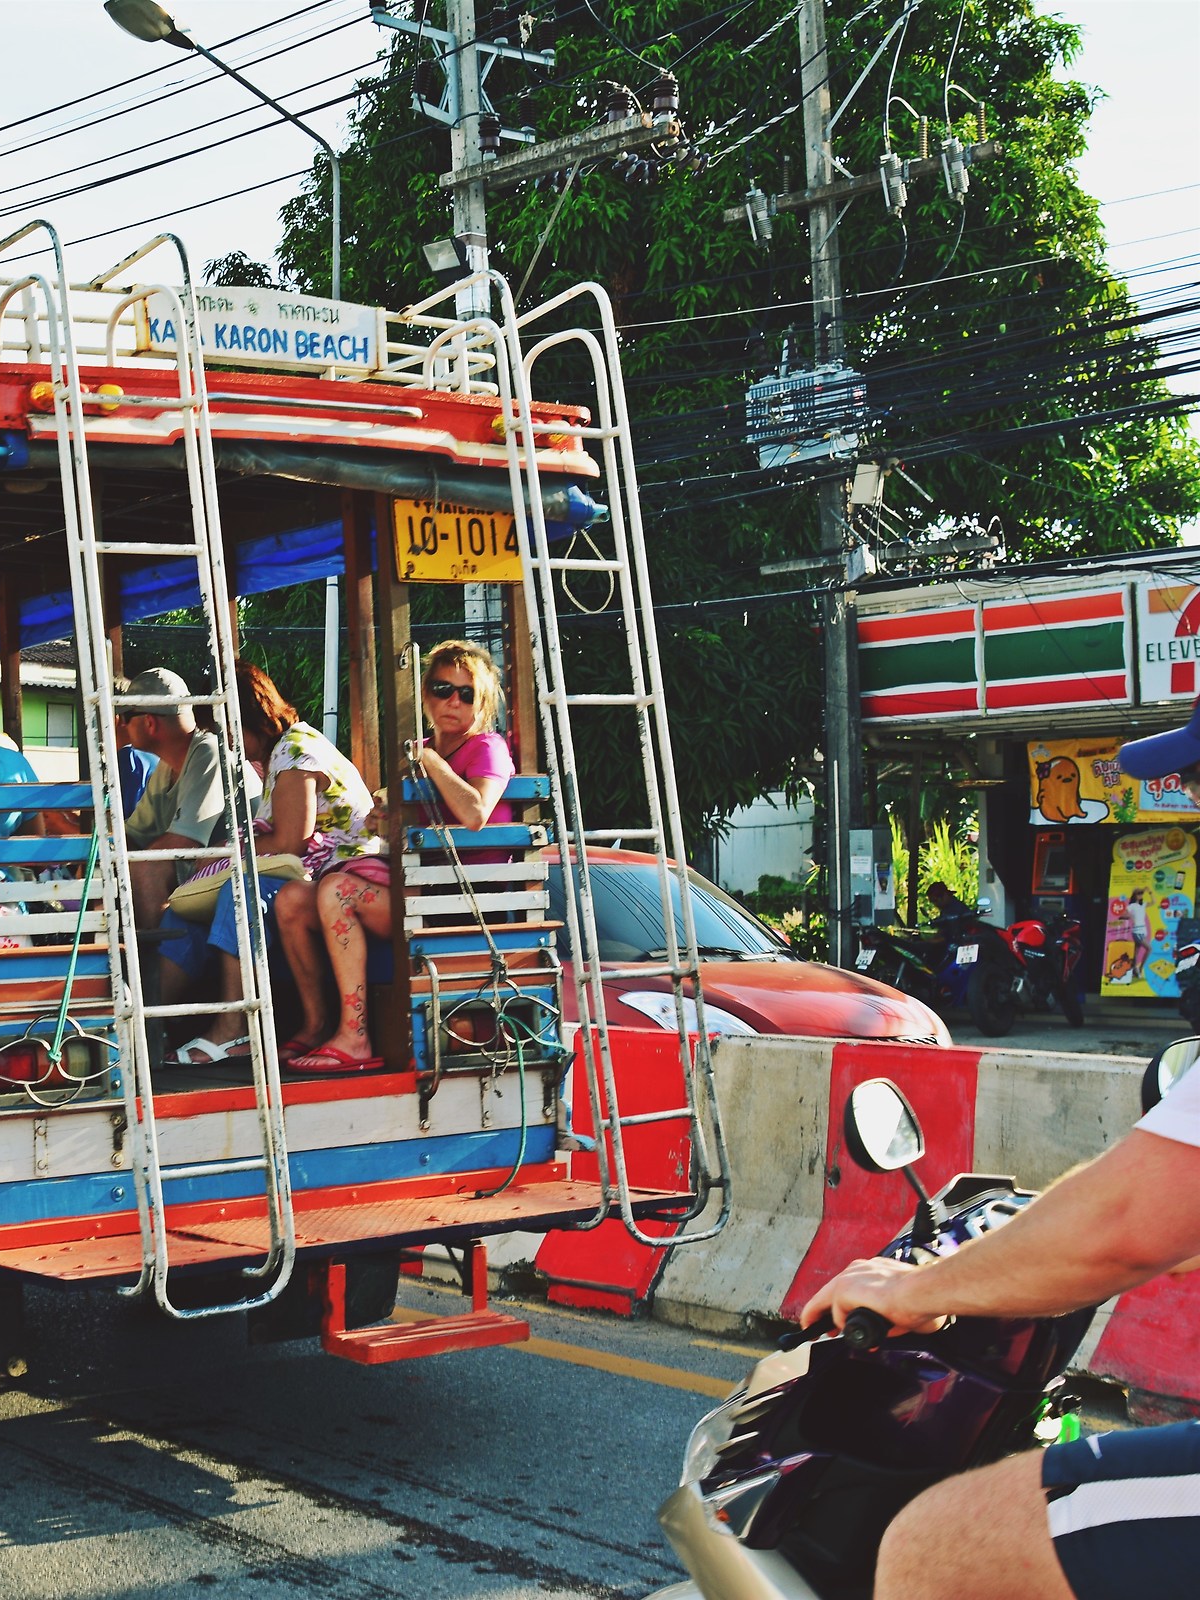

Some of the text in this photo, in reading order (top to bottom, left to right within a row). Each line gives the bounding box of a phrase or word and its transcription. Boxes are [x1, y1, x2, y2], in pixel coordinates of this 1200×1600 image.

[148, 316, 370, 364] KA KARON BEACH
